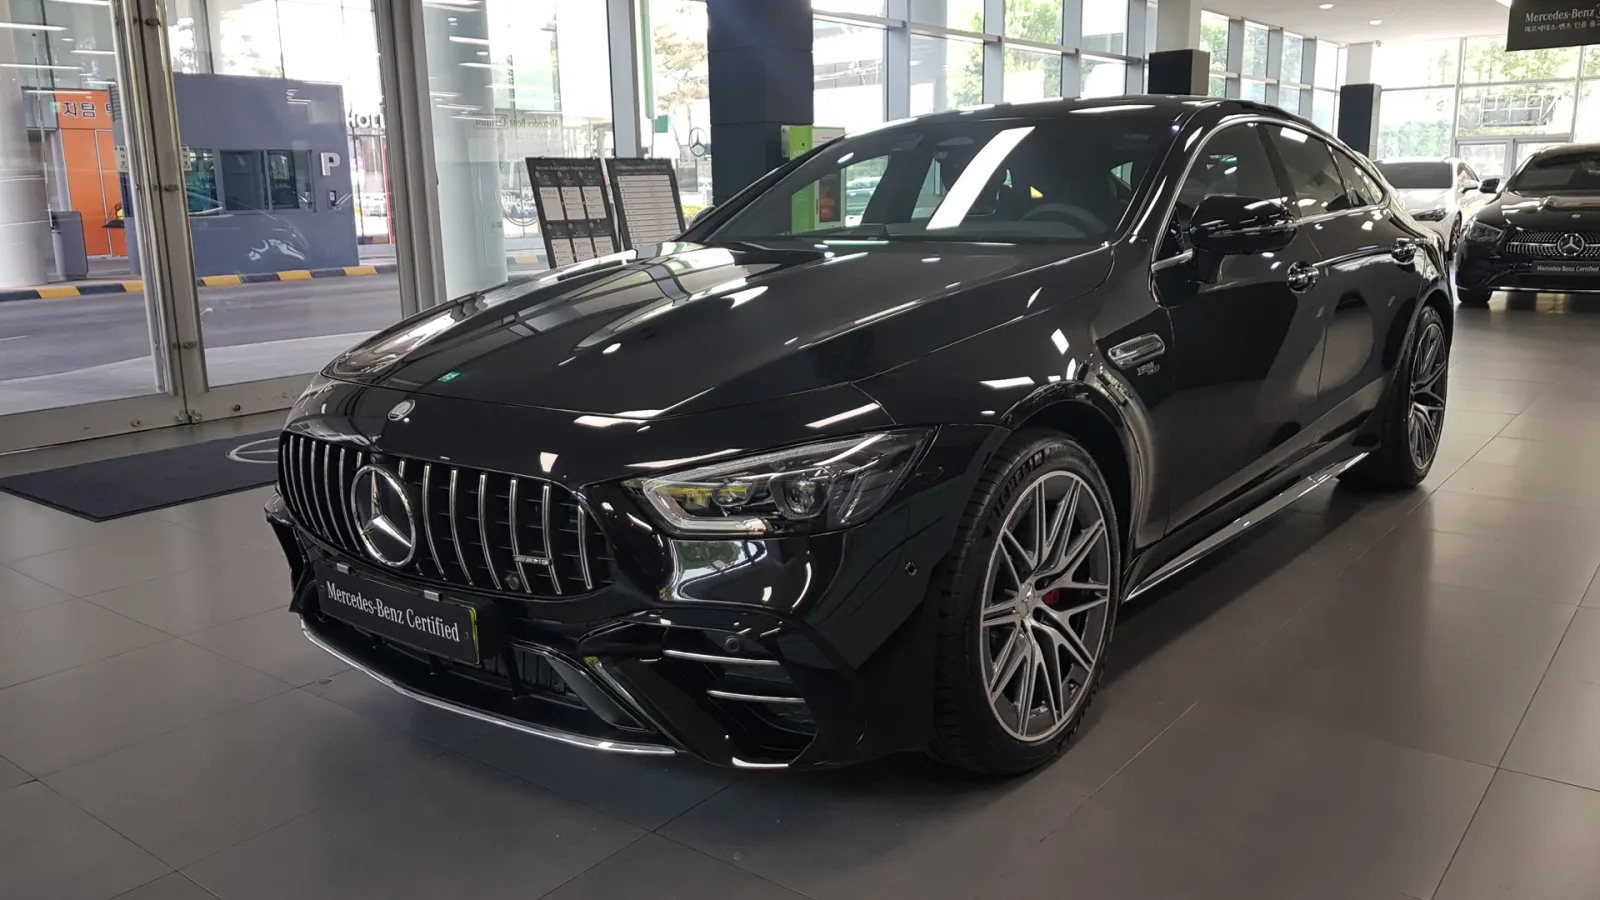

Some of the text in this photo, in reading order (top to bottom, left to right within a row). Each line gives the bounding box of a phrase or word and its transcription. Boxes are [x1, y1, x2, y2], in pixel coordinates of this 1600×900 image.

[1525, 8, 1595, 23] Mercedes-Benz
[320, 152, 341, 176] P
[326, 580, 460, 643] Mercedes-Benz Certified
